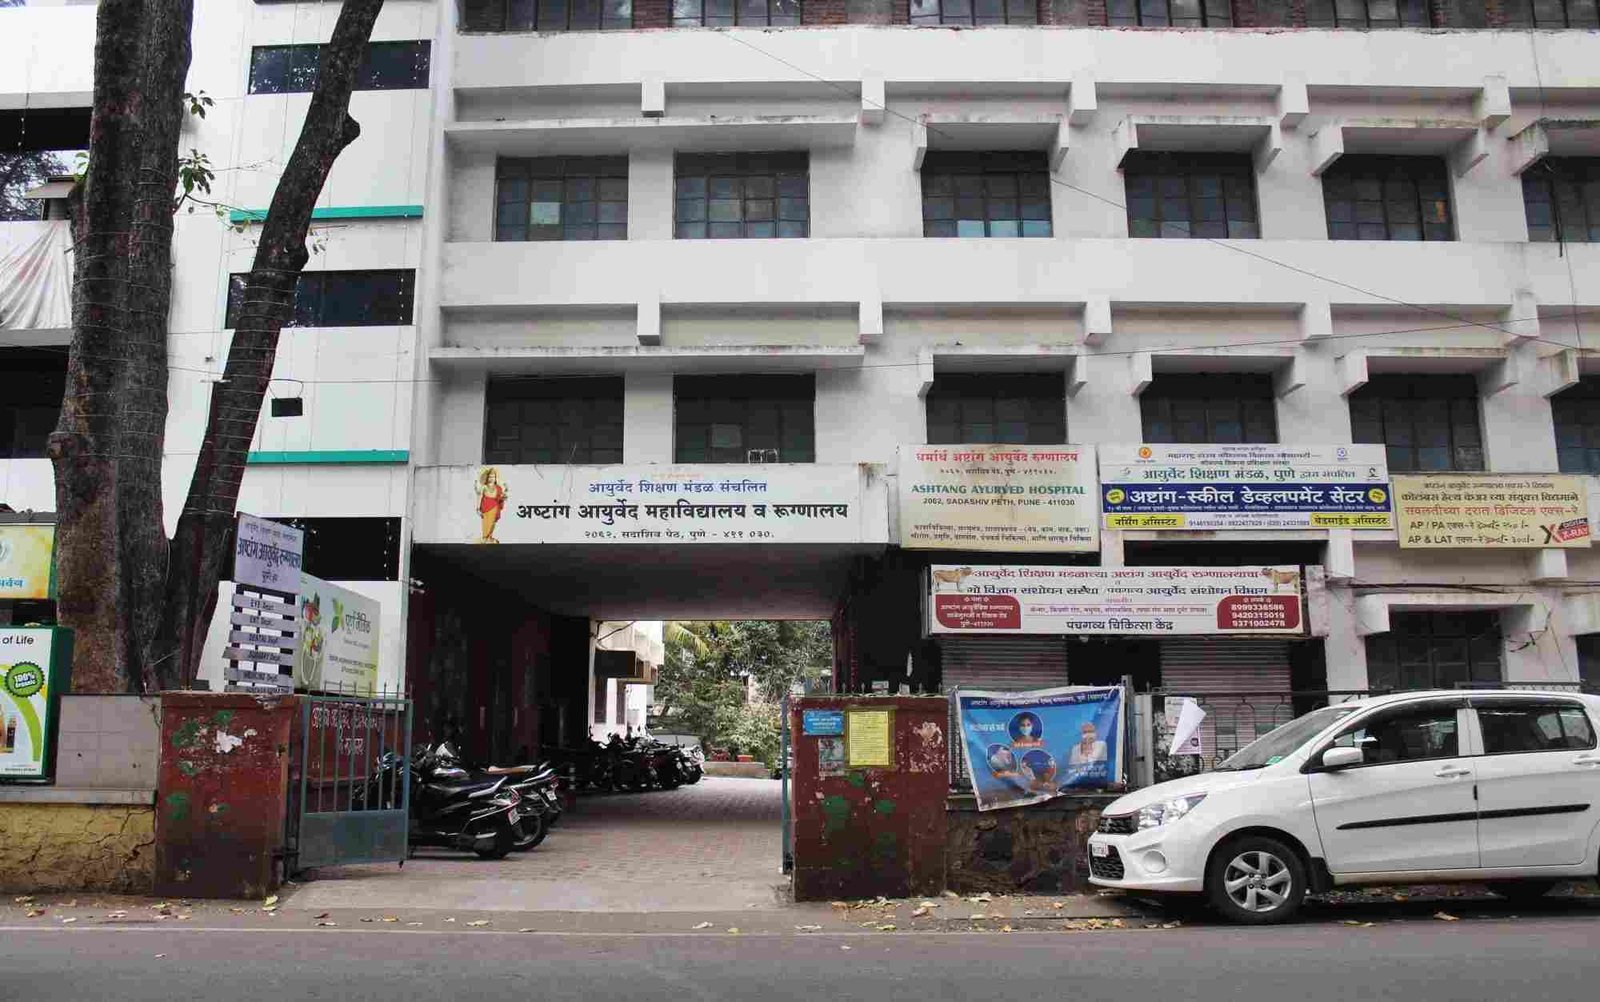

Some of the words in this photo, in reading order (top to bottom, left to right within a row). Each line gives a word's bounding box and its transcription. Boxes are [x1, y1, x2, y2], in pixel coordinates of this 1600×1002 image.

[1142, 467, 1185, 482] आयुर्वेद
[1190, 467, 1229, 479] शिक्षण
[1274, 467, 1296, 482] पुणे
[588, 479, 633, 496] आयुर्वेद
[639, 480, 677, 493] शिक्षण
[684, 480, 714, 493] मंडळ
[720, 479, 767, 493] संचलित
[911, 484, 967, 495] ASHTANG
[971, 484, 1025, 495] AYURVED
[1029, 485, 1087, 496] HOSPITAL
[1240, 486, 1324, 504] डेव्हलपमेंट
[1329, 486, 1366, 503] सेंटर
[946, 498, 989, 506] SADASHIV
[516, 499, 571, 519] अष्टांग
[577, 498, 639, 525] आयुर्वेद
[645, 498, 746, 520] महाविद्यालय
[753, 504, 767, 518] व
[1410, 521, 1423, 529] AP
[1432, 521, 1445, 529] PA
[621, 529, 662, 539] सदाशिव
[690, 529, 706, 541] पुणे
[1408, 535, 1421, 544] AP
[1425, 535, 1431, 544] &
[1434, 535, 1453, 544] LAT
[974, 568, 1014, 580] आयुर्वेद
[1148, 568, 1187, 580] आयुर्वेद
[1146, 585, 1186, 598] आयुर्वेद
[1109, 617, 1152, 630] चिकित्सा
[1155, 617, 1174, 630] केंद्र
[2, 635, 13, 644] of
[16, 635, 34, 645] Life
